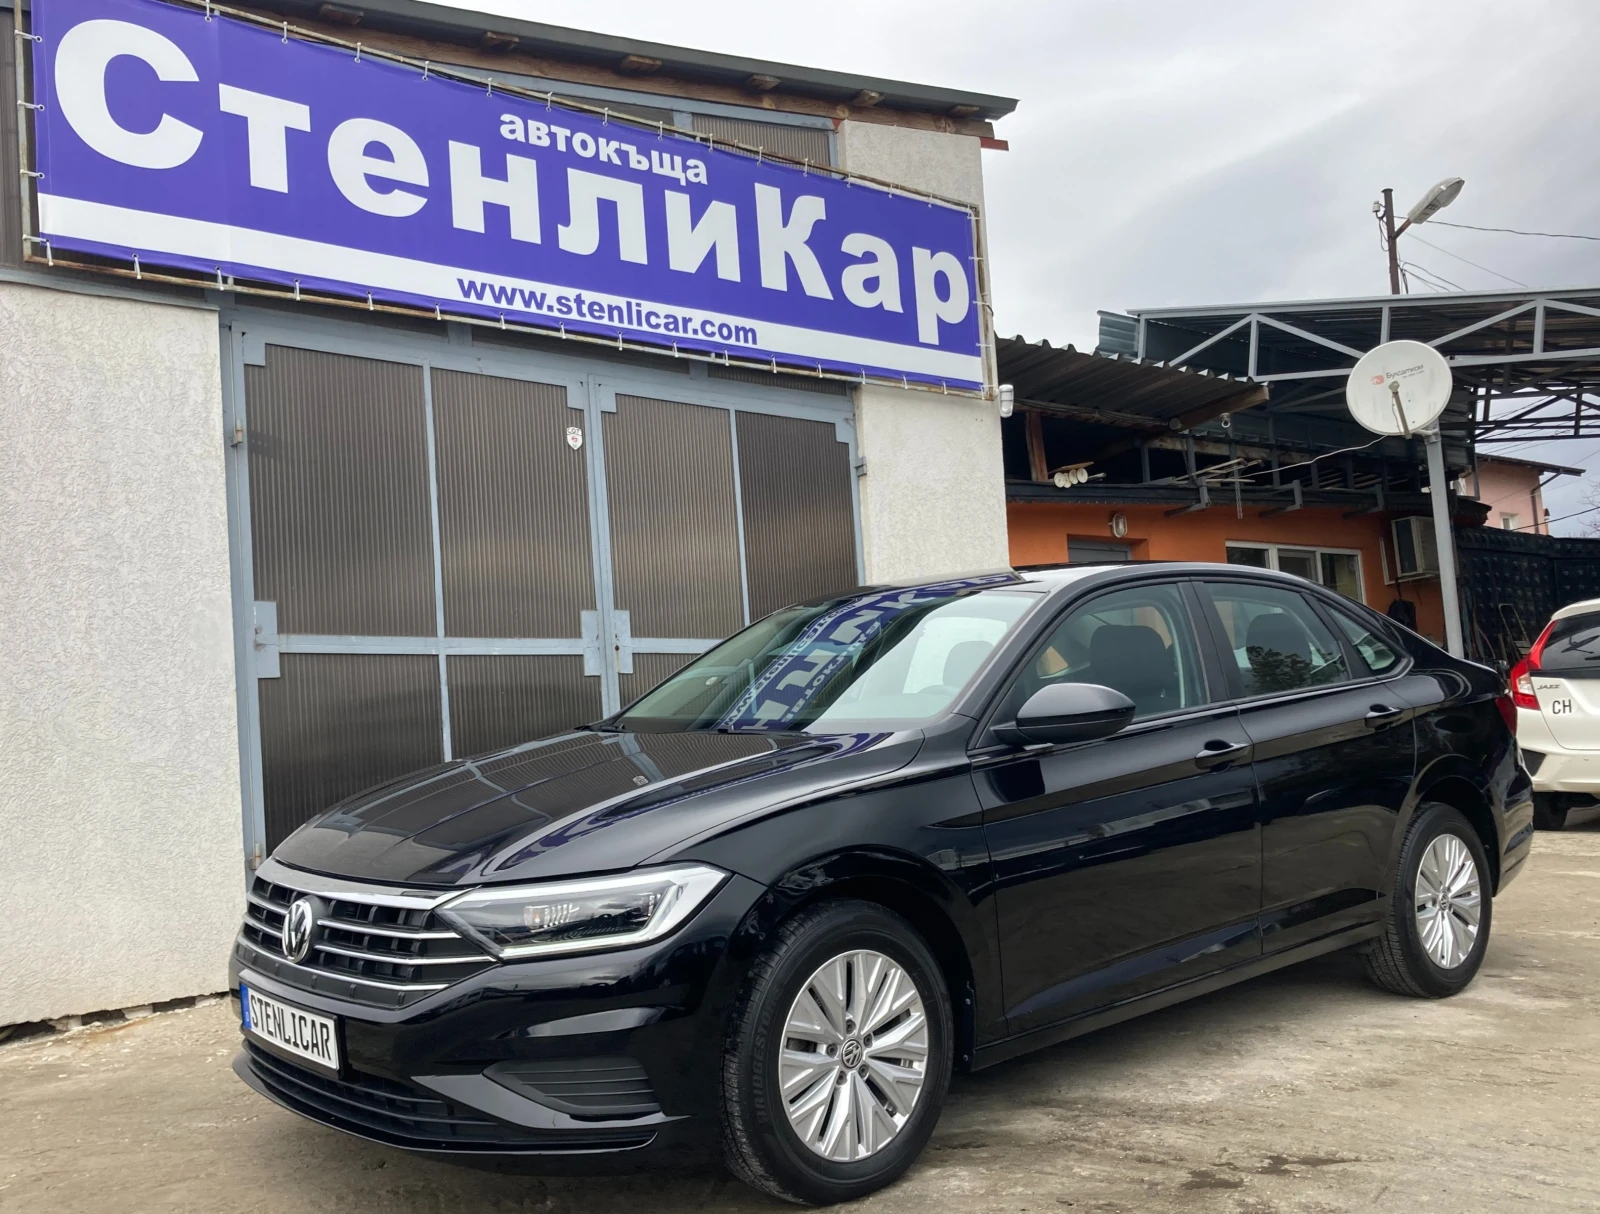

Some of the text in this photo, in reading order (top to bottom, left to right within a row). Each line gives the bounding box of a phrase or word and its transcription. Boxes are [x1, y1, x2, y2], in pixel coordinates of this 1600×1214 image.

[54, 19, 970, 346] СтенлиКар
[499, 110, 708, 187] автокъща
[456, 277, 758, 346] www.stenlicar.com
[1552, 699, 1572, 715] CH
[250, 994, 332, 1061] STENLICAR
